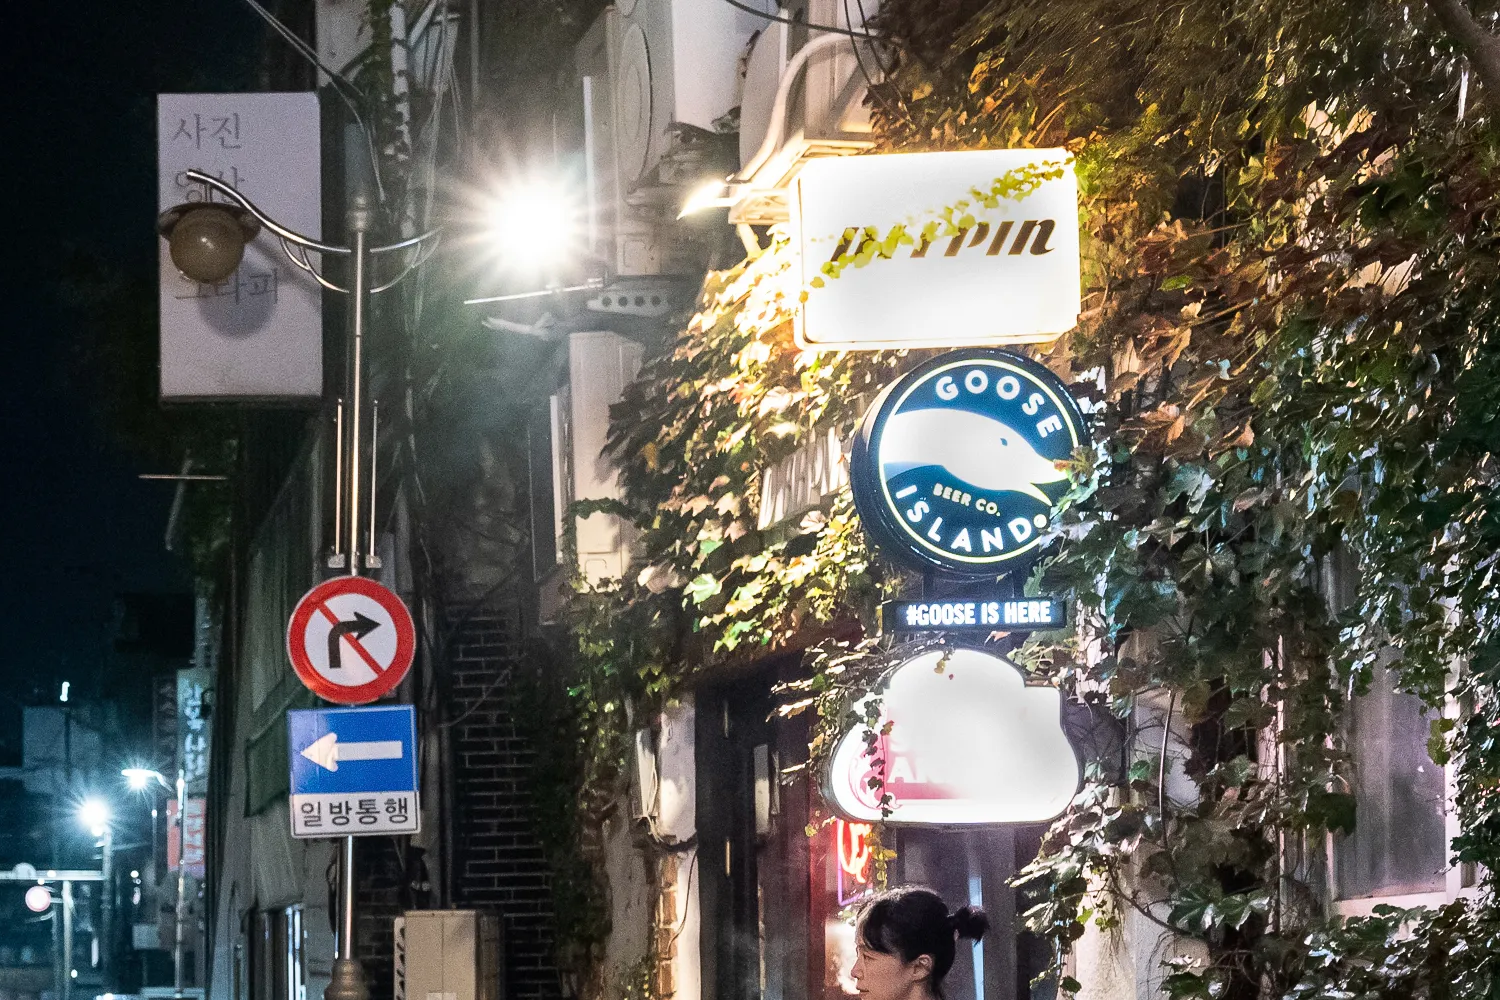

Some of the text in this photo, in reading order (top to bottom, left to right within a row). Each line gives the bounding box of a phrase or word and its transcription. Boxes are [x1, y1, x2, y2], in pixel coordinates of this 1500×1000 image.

[172, 113, 241, 149] 사진
[935, 369, 1063, 438] GOOSE
[932, 483, 1001, 517] BEER CO.
[895, 484, 1032, 553] ISLAND
[906, 600, 1052, 626] #GOOSE IS HERE
[301, 797, 408, 828] 일방통행
